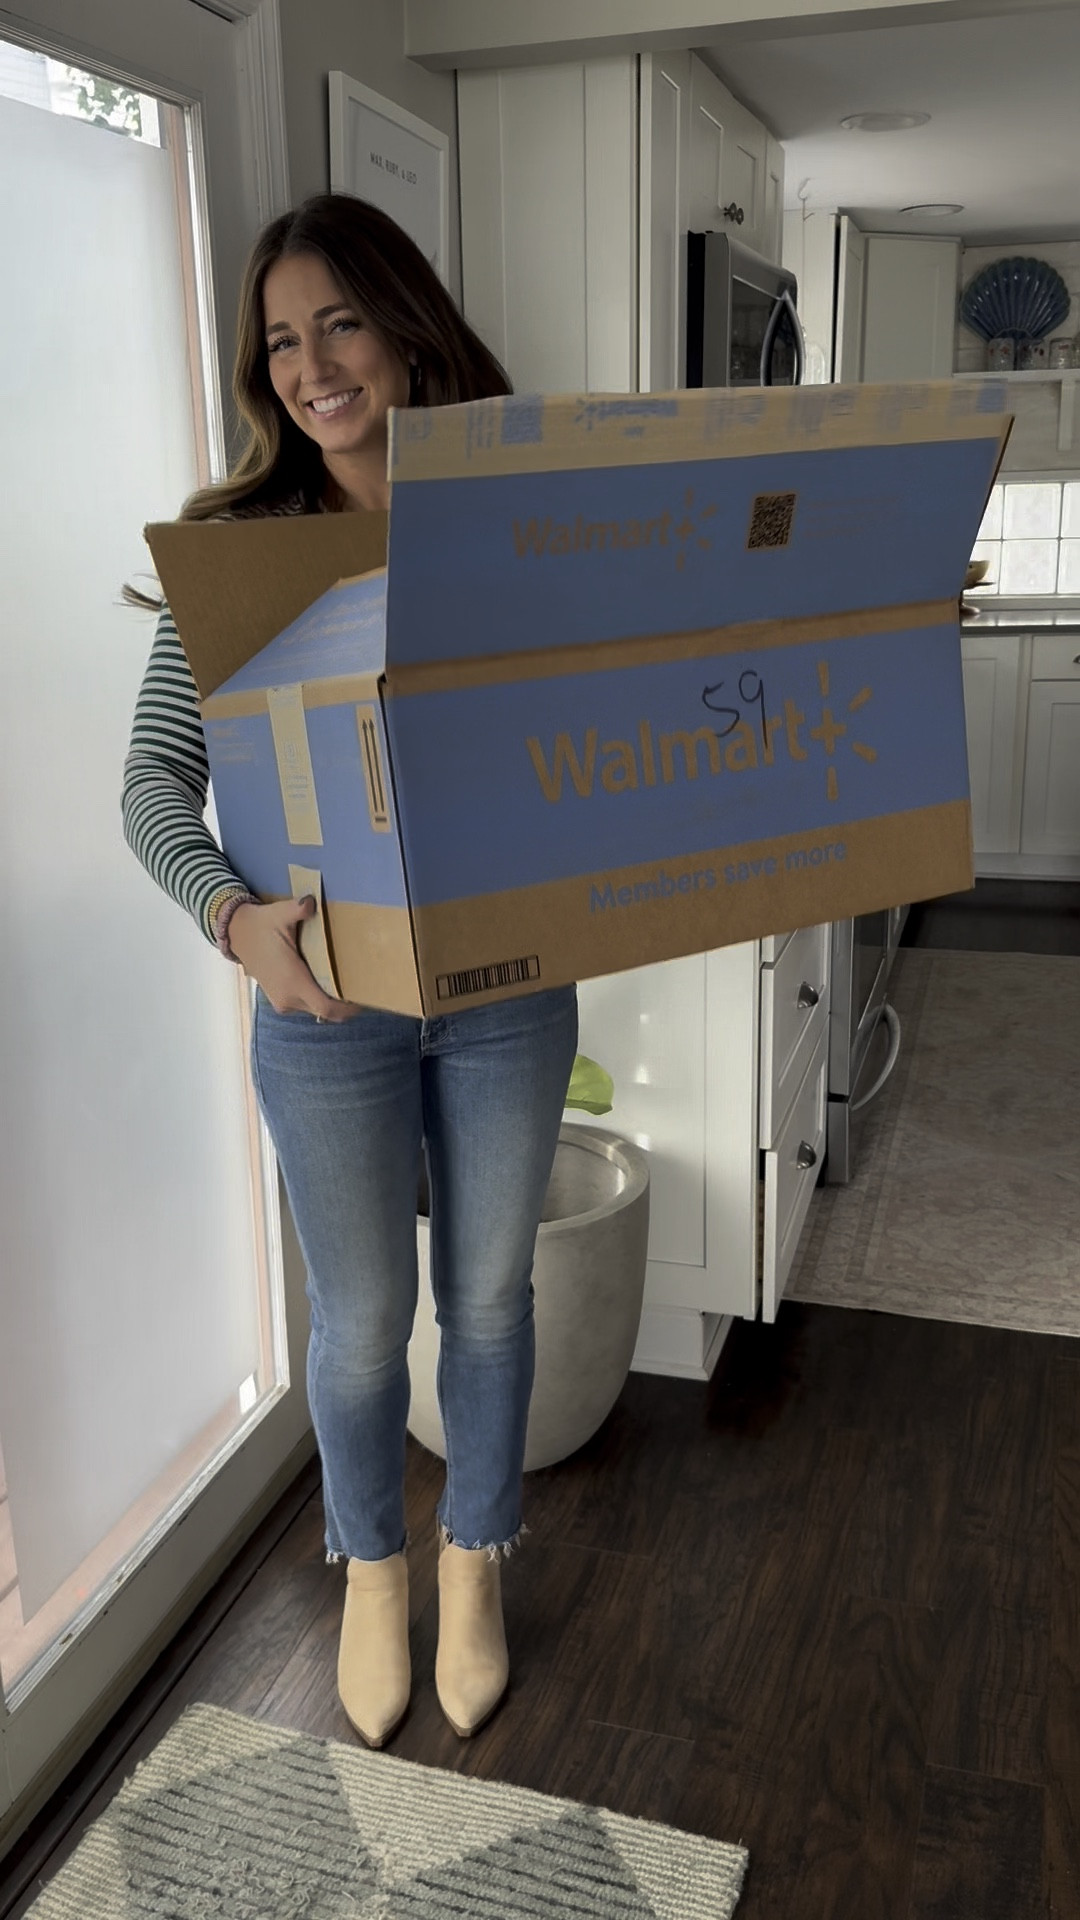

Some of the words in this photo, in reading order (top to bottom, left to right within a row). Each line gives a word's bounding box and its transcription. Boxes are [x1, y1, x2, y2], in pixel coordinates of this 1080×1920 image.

[702, 669, 769, 750] 59
[588, 867, 717, 914] Members
[723, 856, 779, 885] save
[785, 840, 848, 872] more
